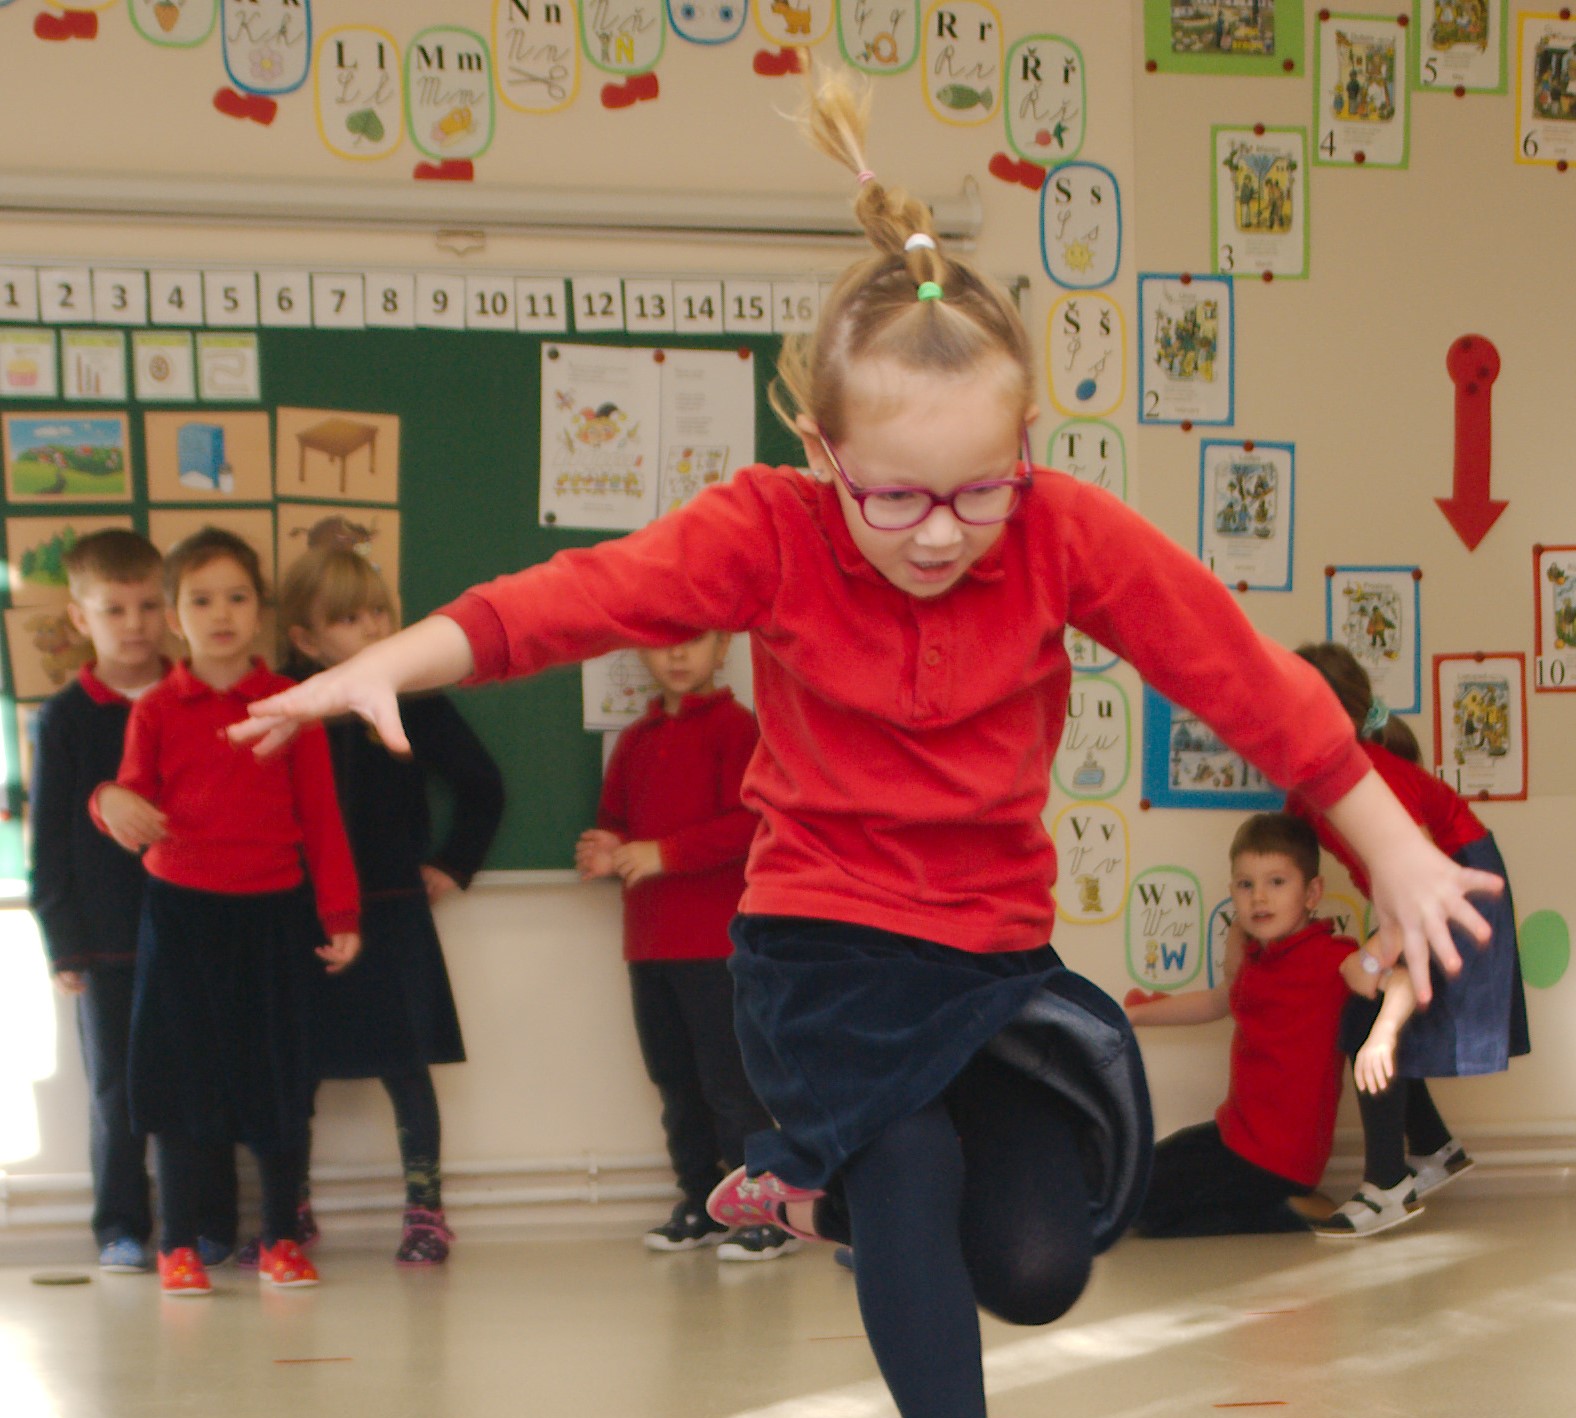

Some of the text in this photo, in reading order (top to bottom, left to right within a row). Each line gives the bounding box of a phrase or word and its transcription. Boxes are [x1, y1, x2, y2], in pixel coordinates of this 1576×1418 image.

[545, 4, 562, 24] n
[937, 10, 993, 41] R r
[336, 40, 358, 69] L
[416, 44, 483, 71] M m
[1022, 46, 1077, 84] Ř ř
[1423, 57, 1438, 86] 5
[1319, 129, 1337, 158] 4
[1523, 130, 1539, 158] 6
[1055, 177, 1102, 205] S s
[1220, 243, 1235, 274] 3
[5, 281, 813, 321] 1 2 3 4 5 6 7 8 9 10 11 12 13 14 15 16
[1063, 301, 1111, 336] Š š
[1145, 389, 1160, 418] 2
[1061, 432, 1108, 459] T t
[1537, 658, 1566, 688] 10
[1067, 693, 1113, 718] U u
[1070, 816, 1116, 841] V v
[1138, 883, 1195, 906] W w
[1160, 942, 1187, 971] W
